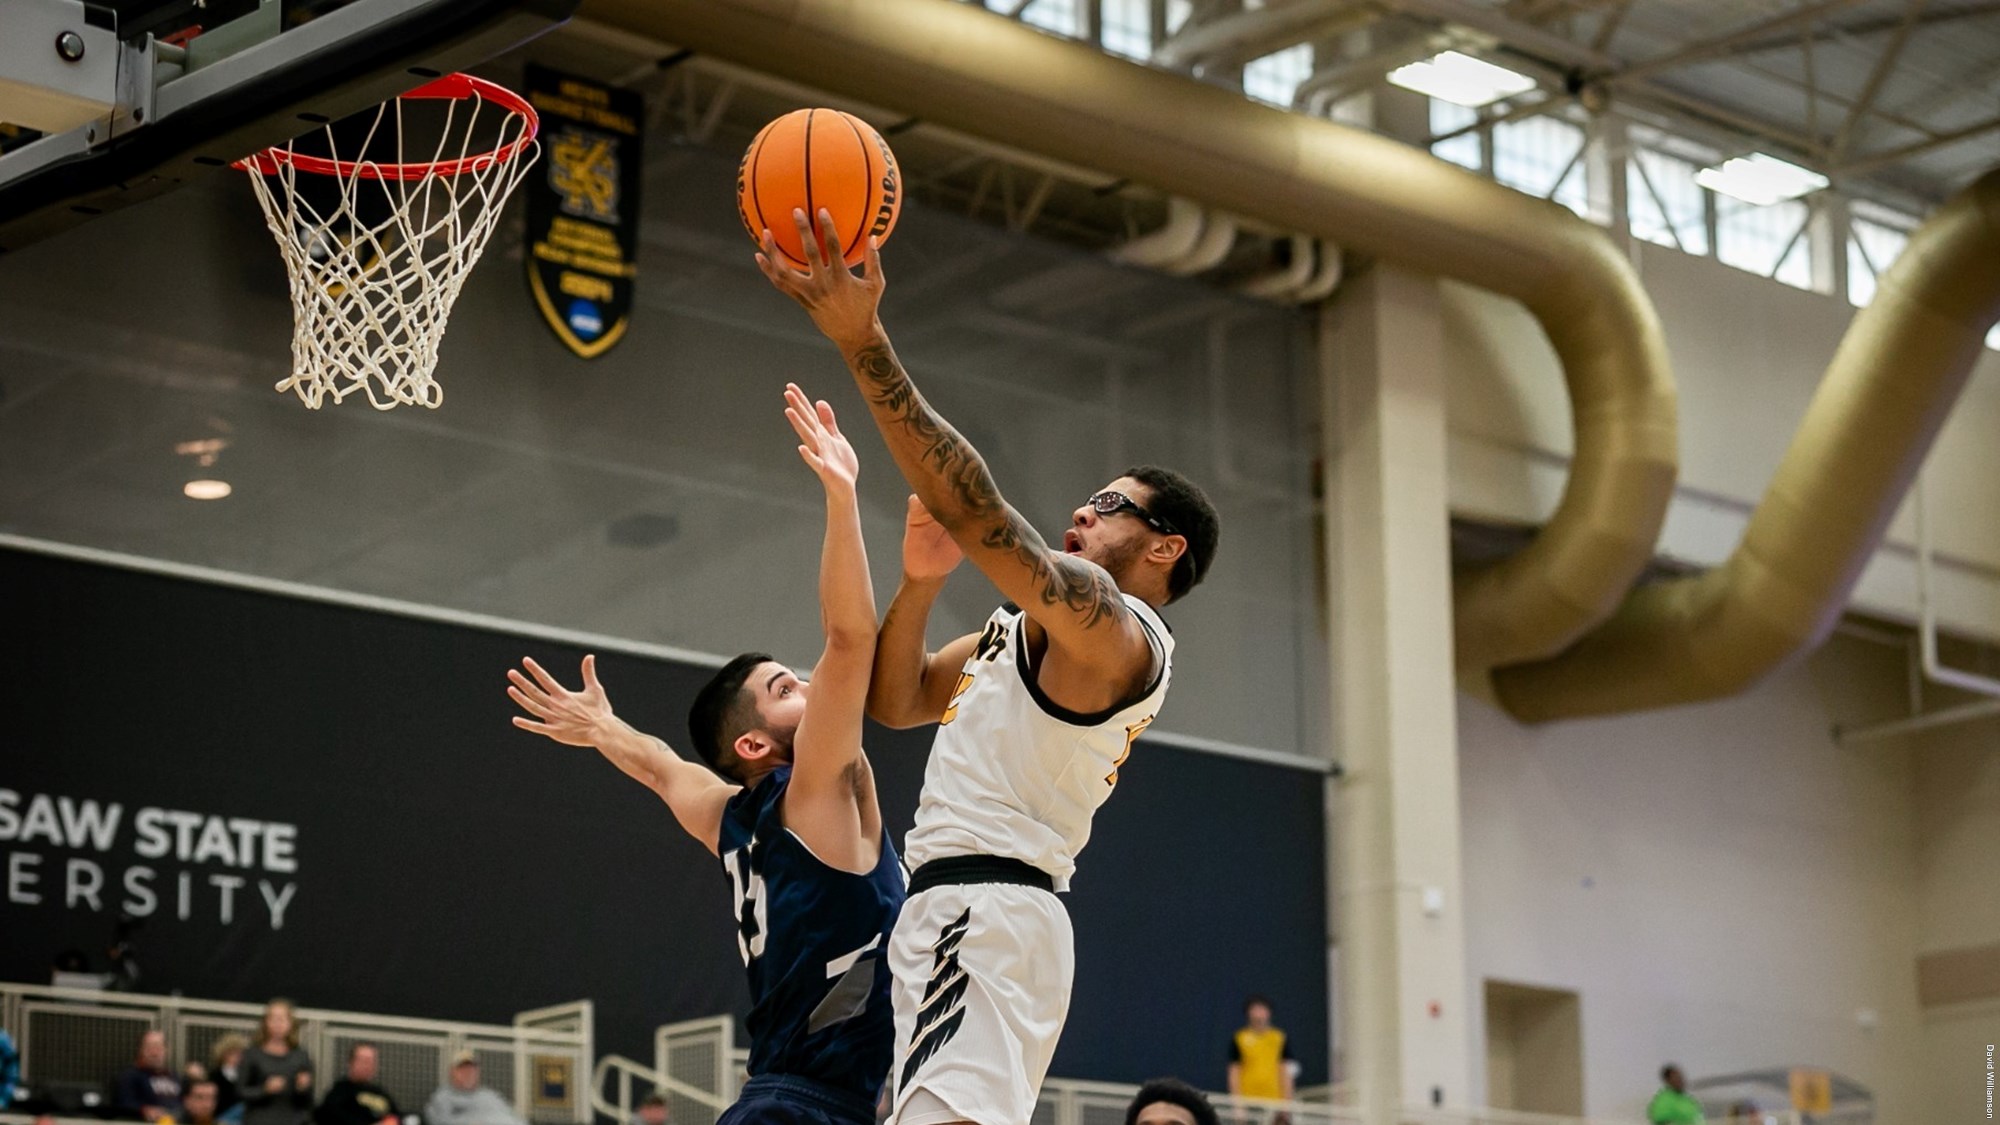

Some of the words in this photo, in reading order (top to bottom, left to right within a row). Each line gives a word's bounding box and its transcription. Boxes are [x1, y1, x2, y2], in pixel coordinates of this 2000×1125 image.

[868, 132, 897, 238] Wilson
[134, 806, 298, 874] STATE
[8, 851, 297, 930] ERSITY
